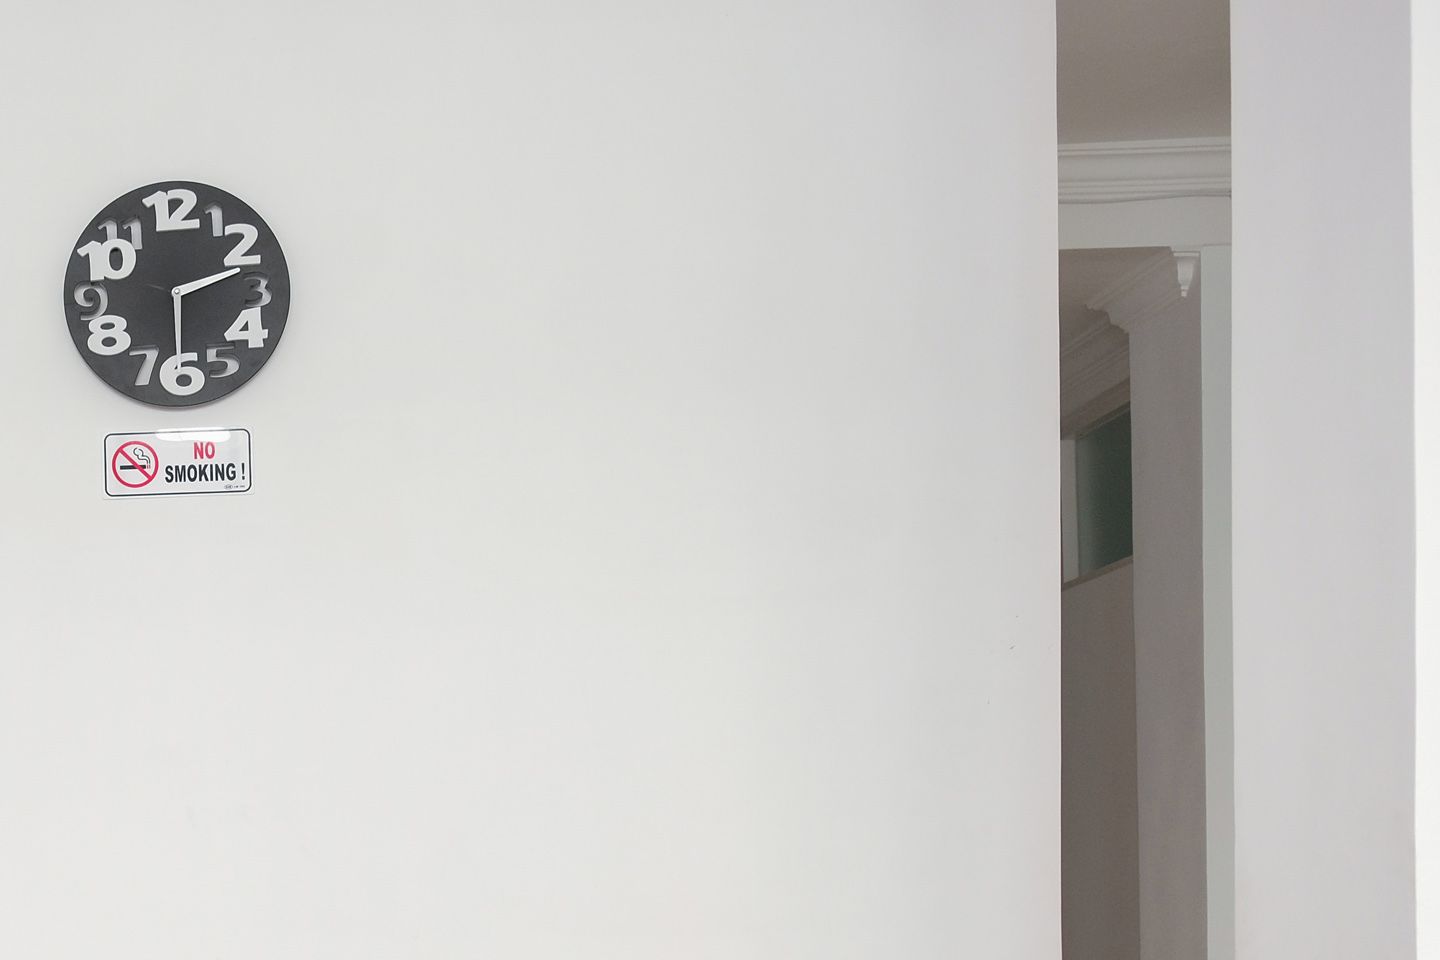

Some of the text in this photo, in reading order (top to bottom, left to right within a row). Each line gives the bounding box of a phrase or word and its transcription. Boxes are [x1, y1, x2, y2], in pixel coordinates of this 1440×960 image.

[142, 189, 200, 231] 12
[204, 203, 224, 237] 1
[77, 238, 136, 282] 10
[223, 223, 261, 266] 2
[74, 281, 108, 321] 9
[243, 272, 273, 307] 3
[87, 315, 131, 356] 8
[224, 307, 269, 348] 4
[128, 346, 159, 386] 7
[160, 352, 205, 396] 6
[206, 345, 240, 378] 5
[193, 442, 216, 460] NO
